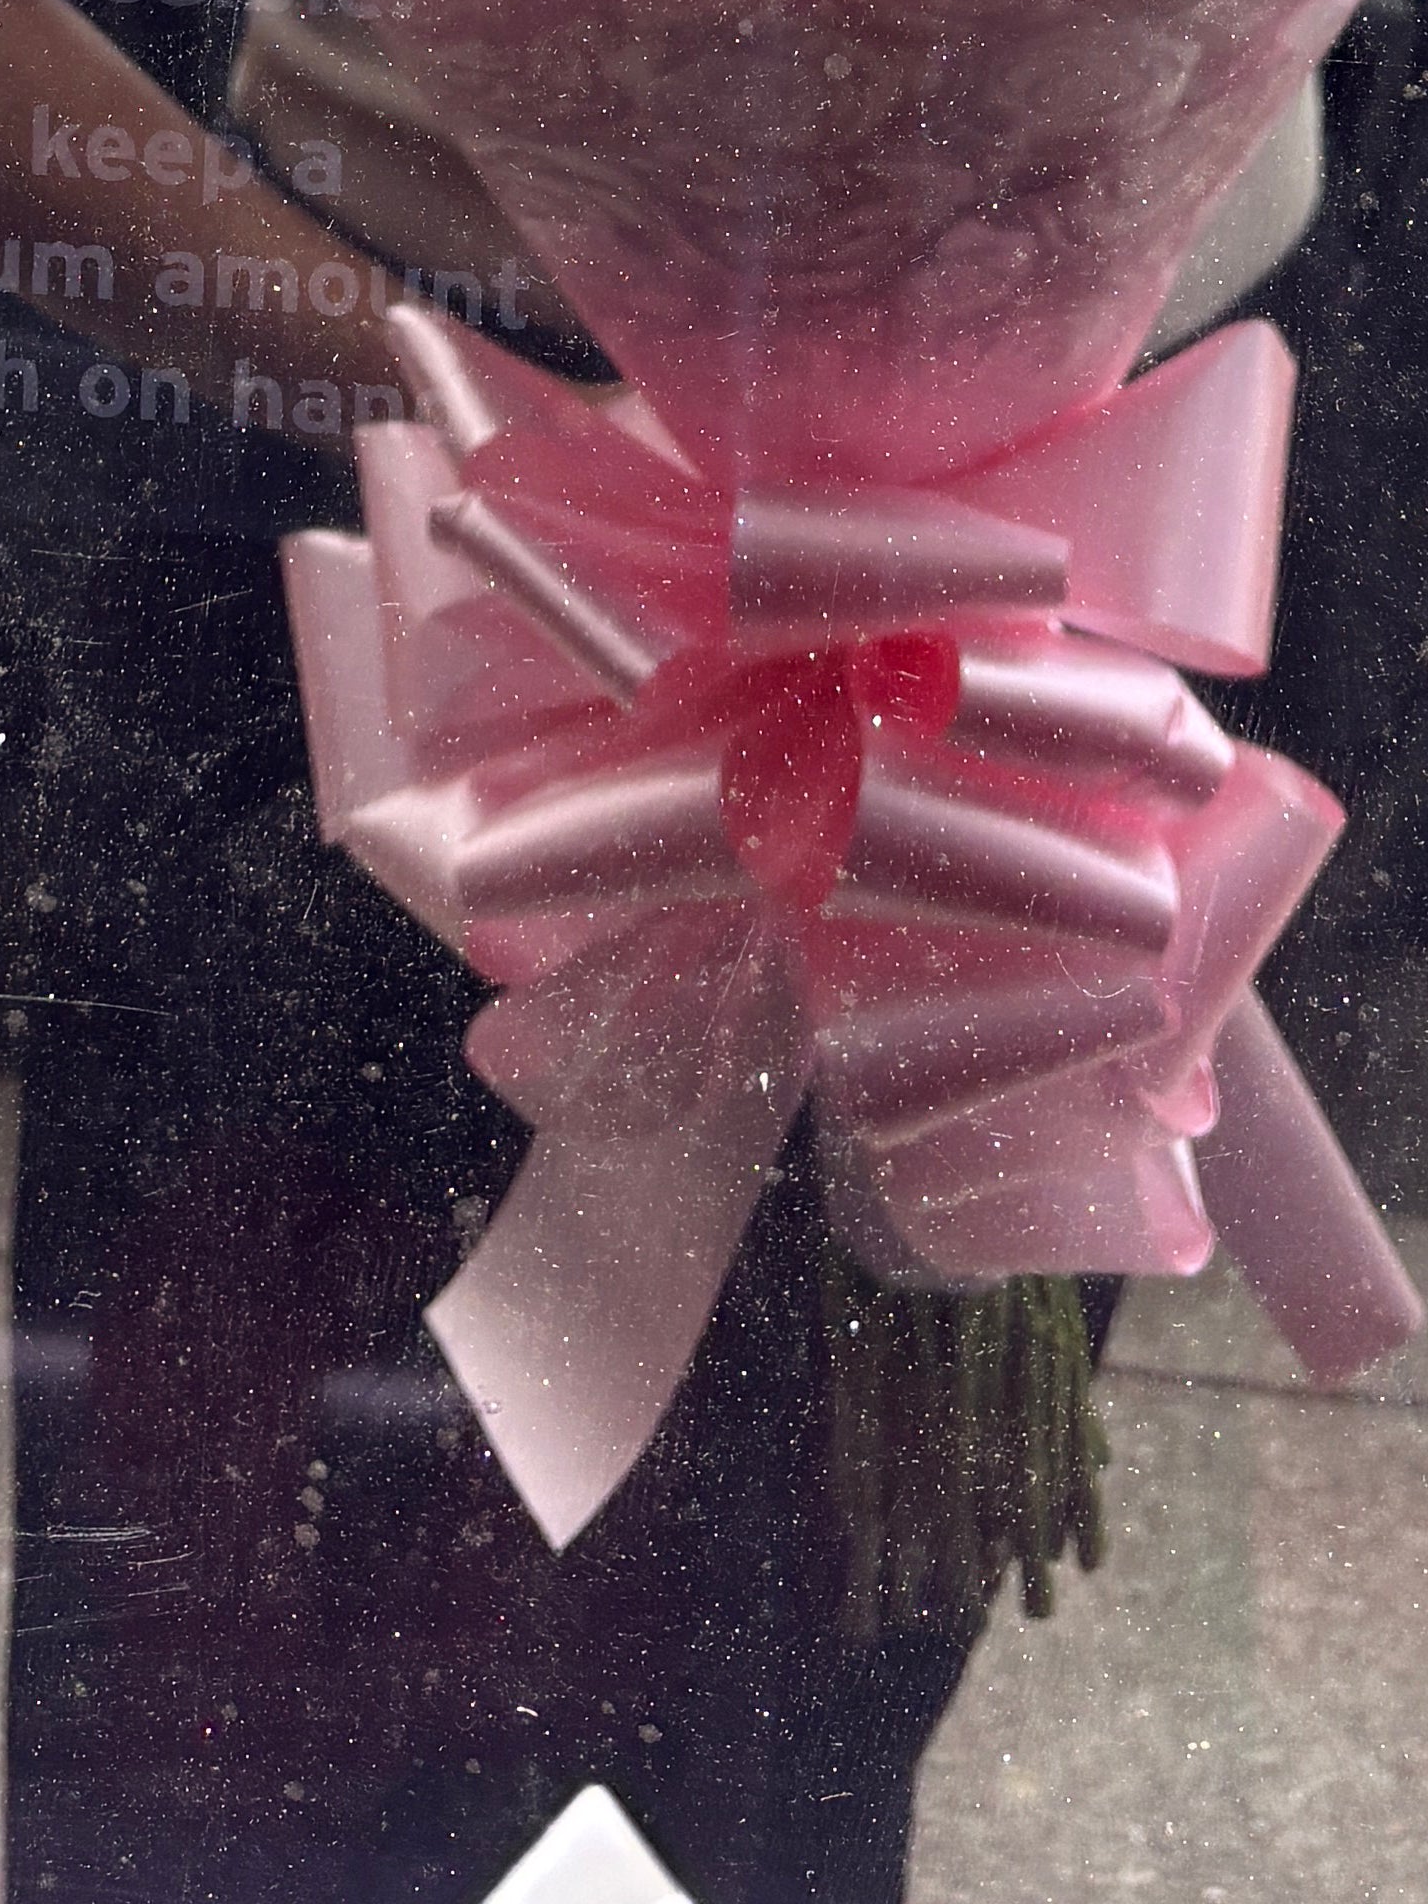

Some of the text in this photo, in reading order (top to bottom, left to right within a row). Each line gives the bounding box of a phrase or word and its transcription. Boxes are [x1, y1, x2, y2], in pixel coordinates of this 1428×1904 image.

[33, 105, 251, 202] keep
[294, 137, 342, 195] a
[156, 252, 529, 331] amount
[80, 358, 189, 424] on
[232, 357, 432, 435] han
